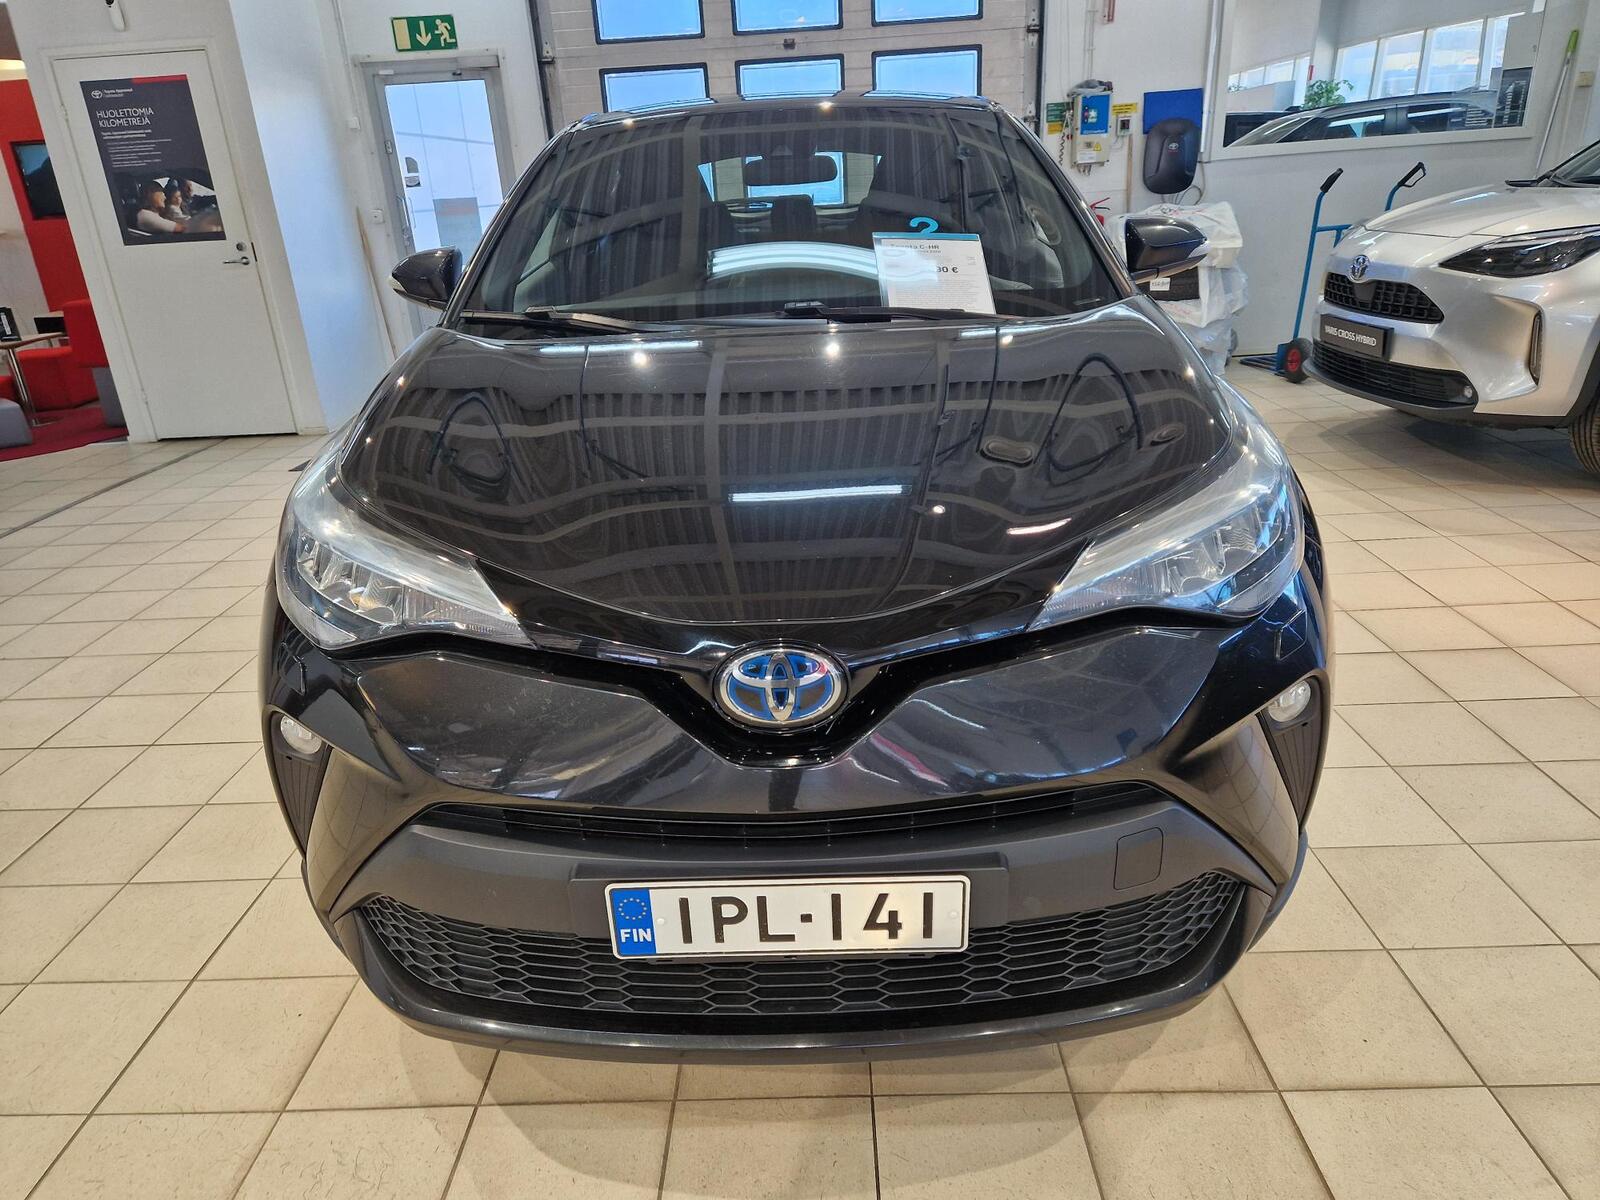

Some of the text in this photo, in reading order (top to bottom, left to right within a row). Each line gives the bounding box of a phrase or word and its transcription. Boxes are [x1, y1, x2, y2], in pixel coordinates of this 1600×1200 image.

[96, 107, 154, 118] HUOLETTOMIA
[1337, 329, 1355, 340] CROSS
[1355, 334, 1376, 346] HYBRID
[678, 891, 934, 945] IPL-141
[620, 928, 652, 943] FIN
